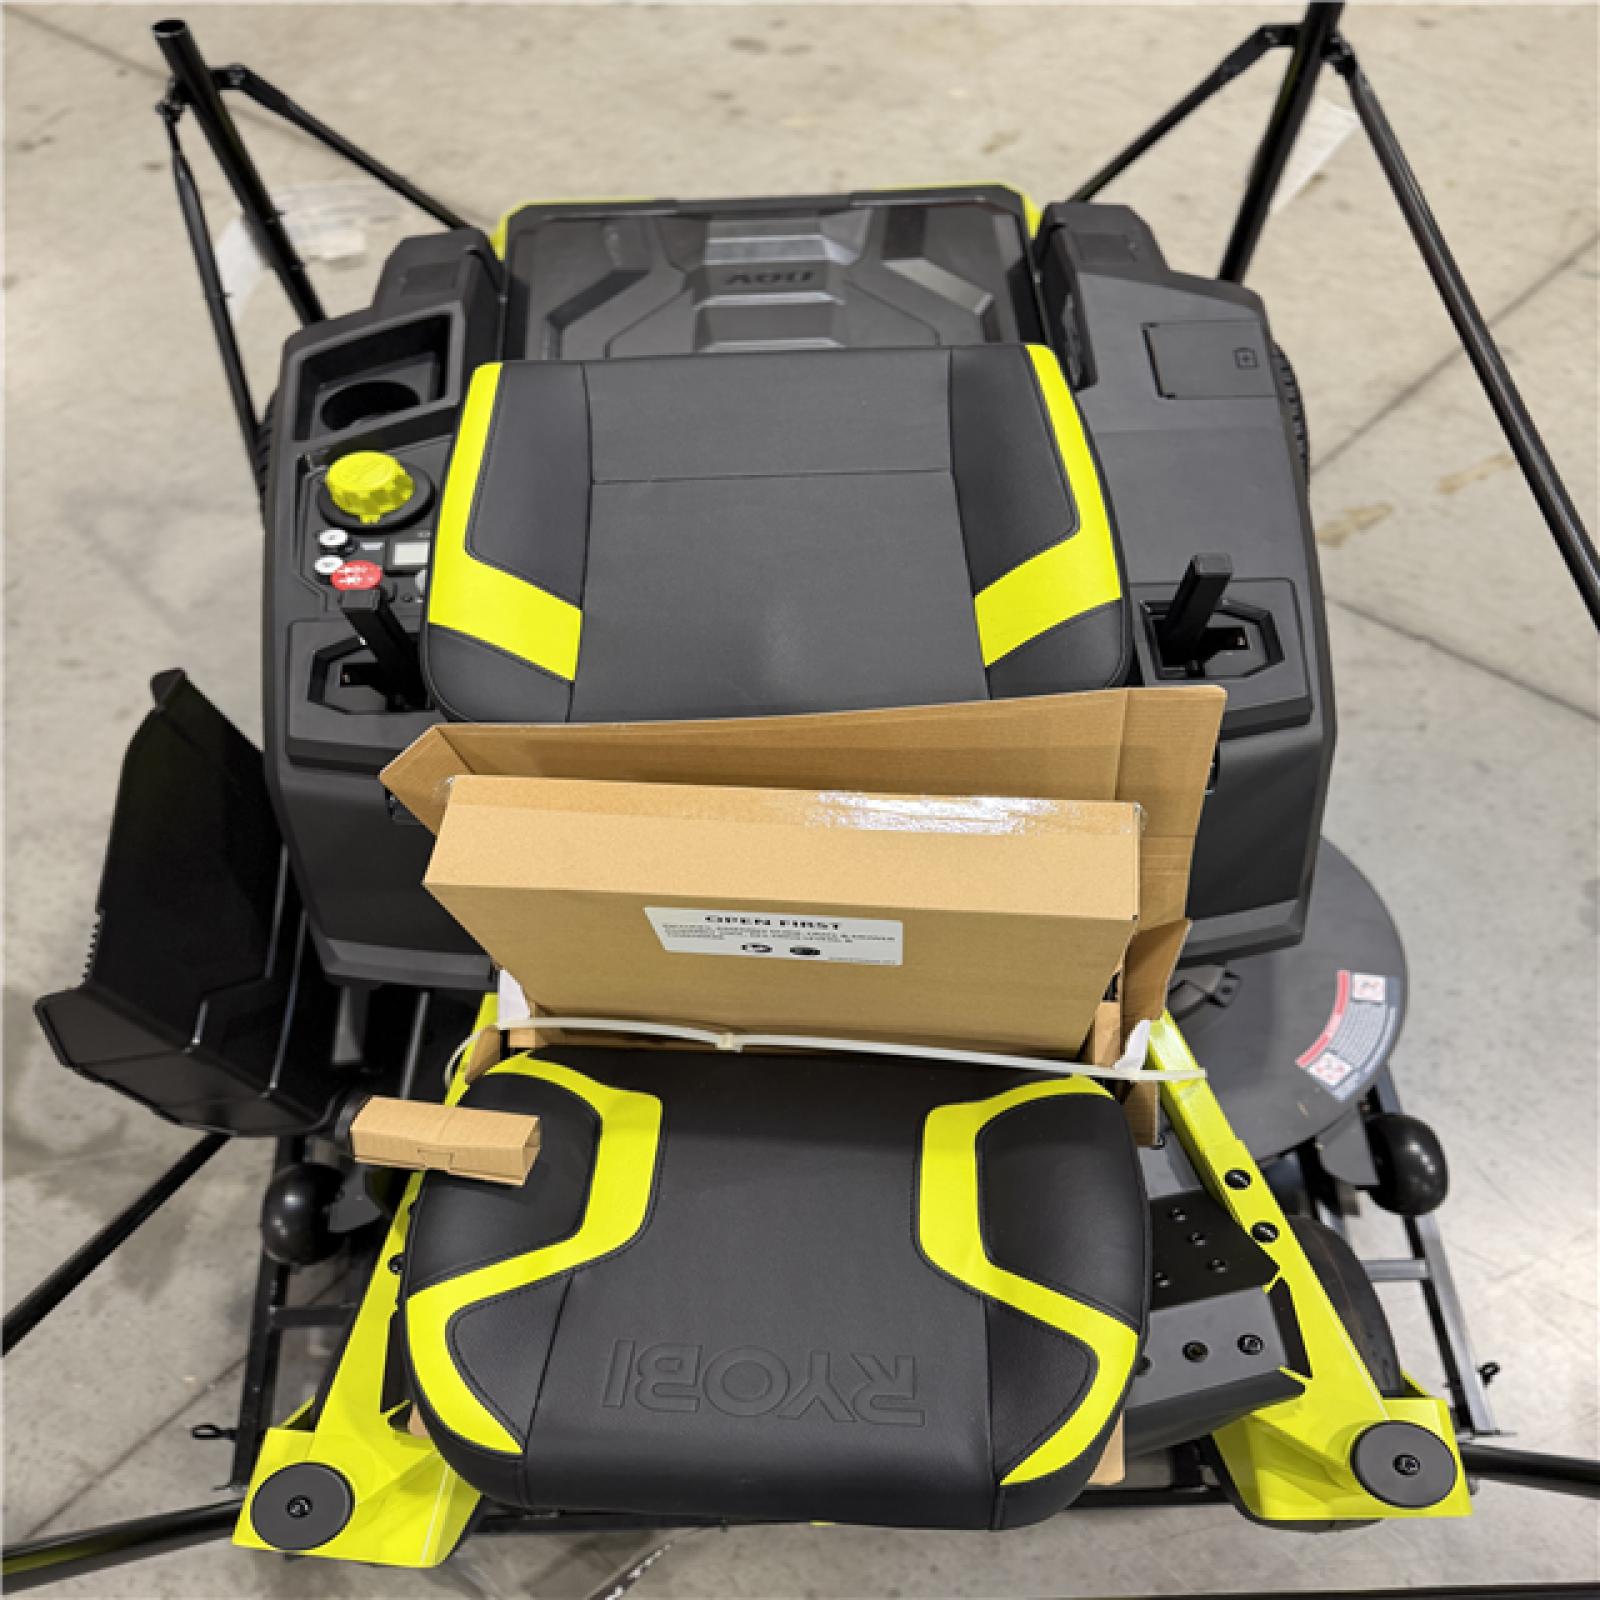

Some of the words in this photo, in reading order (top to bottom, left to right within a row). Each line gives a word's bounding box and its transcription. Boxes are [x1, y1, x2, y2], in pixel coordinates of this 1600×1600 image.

[705, 916, 770, 926] OPEN
[780, 919, 842, 931] FIRST
[602, 1338, 926, 1428] RYOBI
